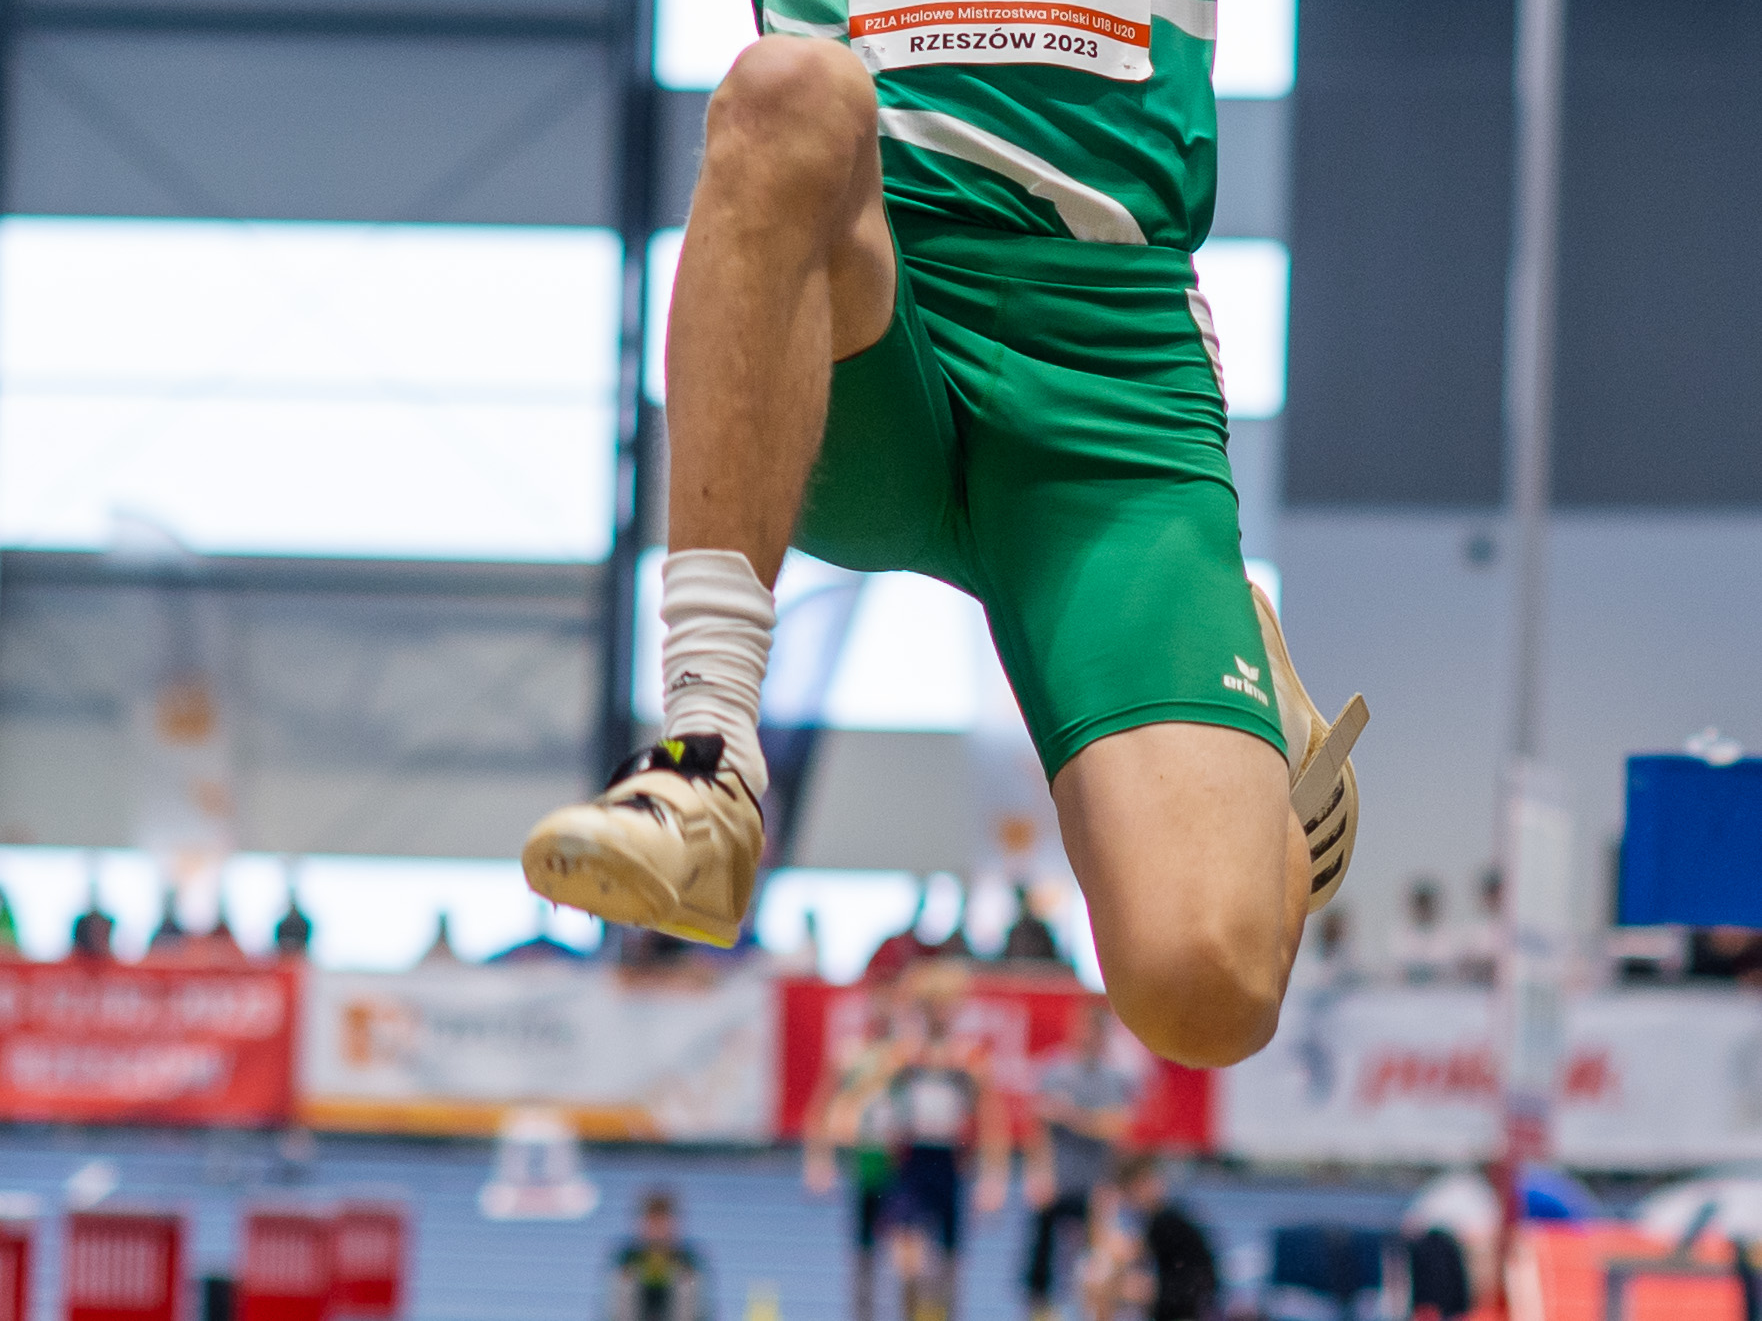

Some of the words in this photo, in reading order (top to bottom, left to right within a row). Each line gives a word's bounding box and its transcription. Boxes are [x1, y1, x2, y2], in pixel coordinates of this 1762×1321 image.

[864, 15, 898, 31] PZLA
[900, 9, 955, 25] Halowe
[957, 6, 1048, 20] Mistrzostwa
[1050, 8, 1091, 26] Polski
[1092, 15, 1113, 33] U18
[1113, 22, 1137, 40] U20
[910, 26, 1037, 53] RZESZÓW
[1043, 32, 1099, 59] 2023
